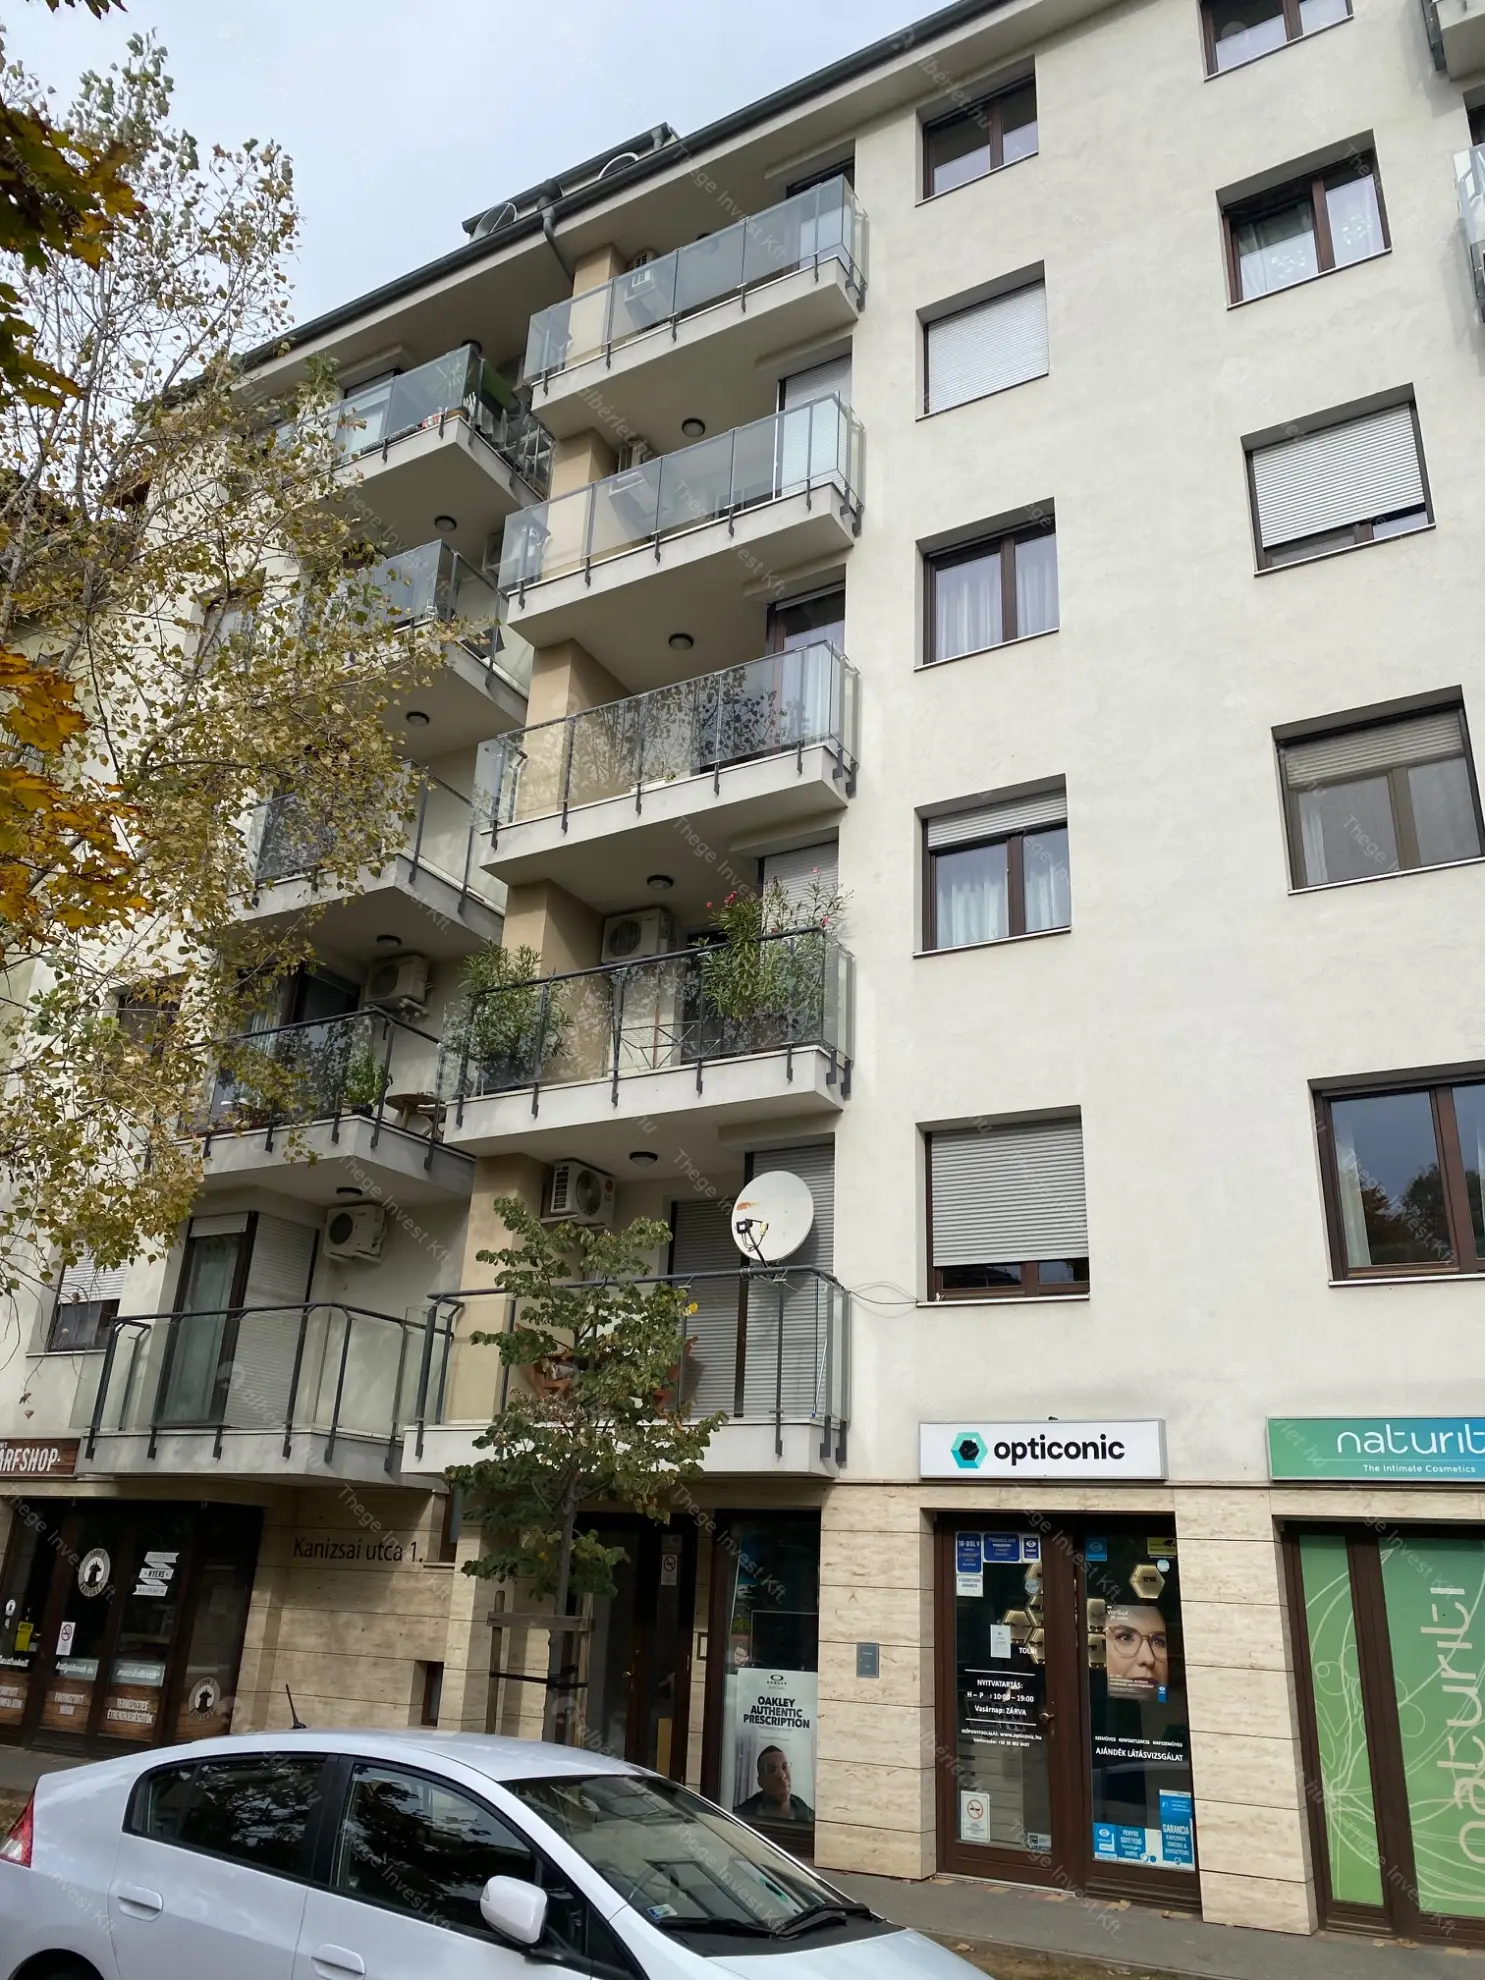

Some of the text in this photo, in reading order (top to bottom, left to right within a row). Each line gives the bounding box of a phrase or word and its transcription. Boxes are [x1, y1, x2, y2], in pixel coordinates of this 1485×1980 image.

[993, 1433, 1125, 1466] opticonic
[1362, 1464, 1476, 1473] The Intimate Cosmetics
[293, 1534, 361, 1564] Kanizsai
[365, 1536, 403, 1563] utca
[410, 1541, 424, 1563] 1.
[977, 1679, 1023, 1689] NYITVATARTÁS:
[757, 1696, 796, 1708] OAKLEY
[1017, 1694, 1034, 1702] 19:00
[750, 1705, 803, 1718] AUTHENTIC
[974, 1704, 1027, 1716] Vasárnap: ZÁRVA
[743, 1714, 810, 1729] PRESCRIPTION
[1095, 1746, 1184, 1762] AJÁNDÉK LÁTÁSVIZSGÁLAT
